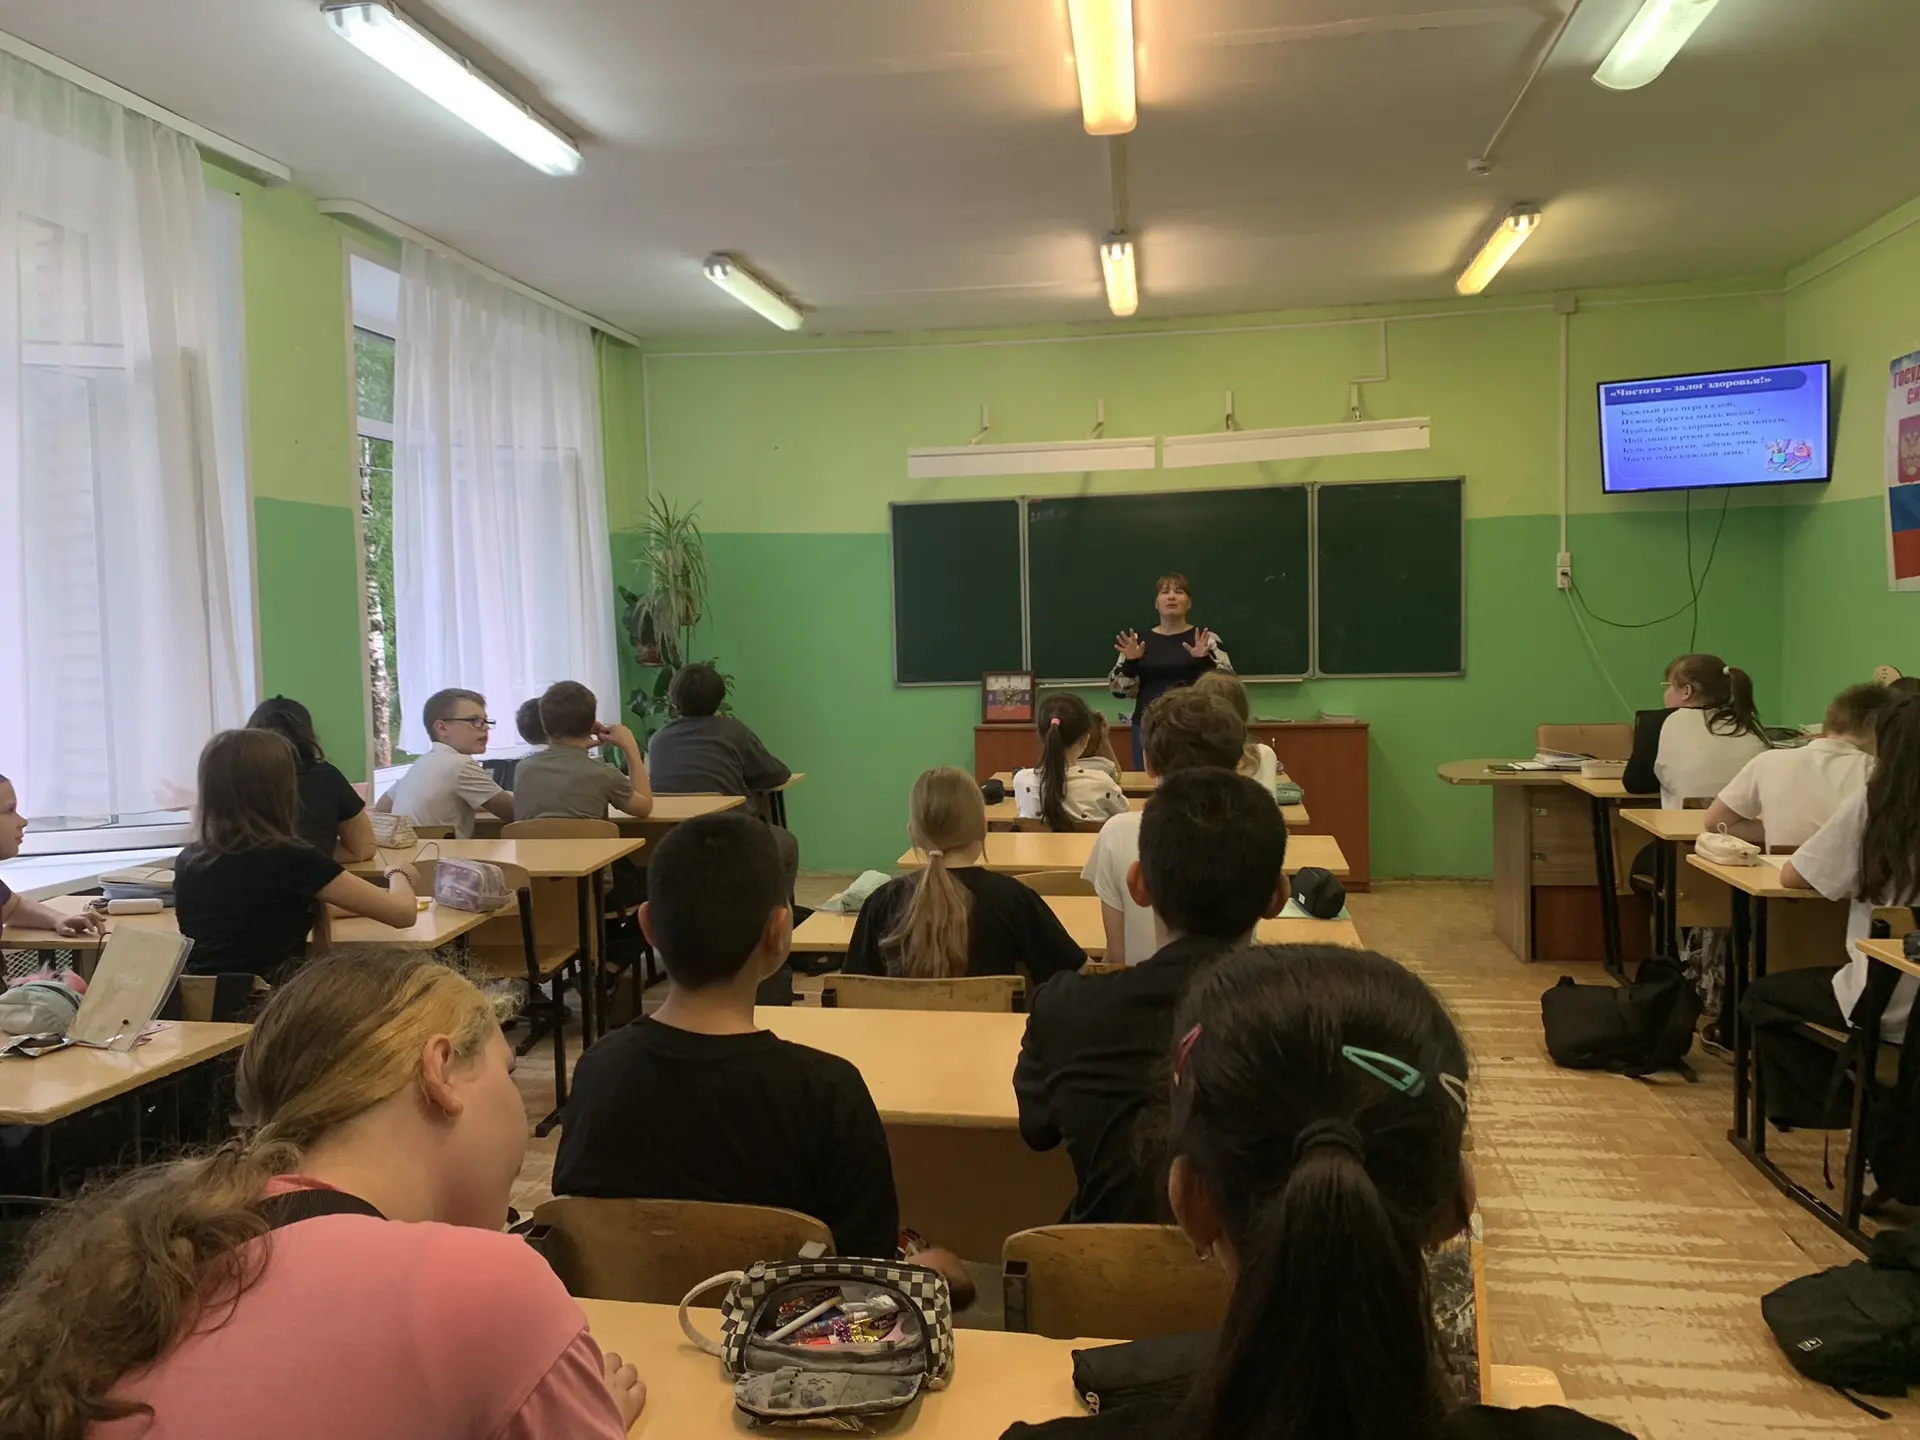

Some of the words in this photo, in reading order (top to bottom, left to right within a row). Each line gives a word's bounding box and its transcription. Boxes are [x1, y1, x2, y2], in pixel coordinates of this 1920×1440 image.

[1610, 387, 1662, 397] «Чистота
[1674, 383, 1705, 392] залог
[1707, 376, 1772, 388] здоровья!»
